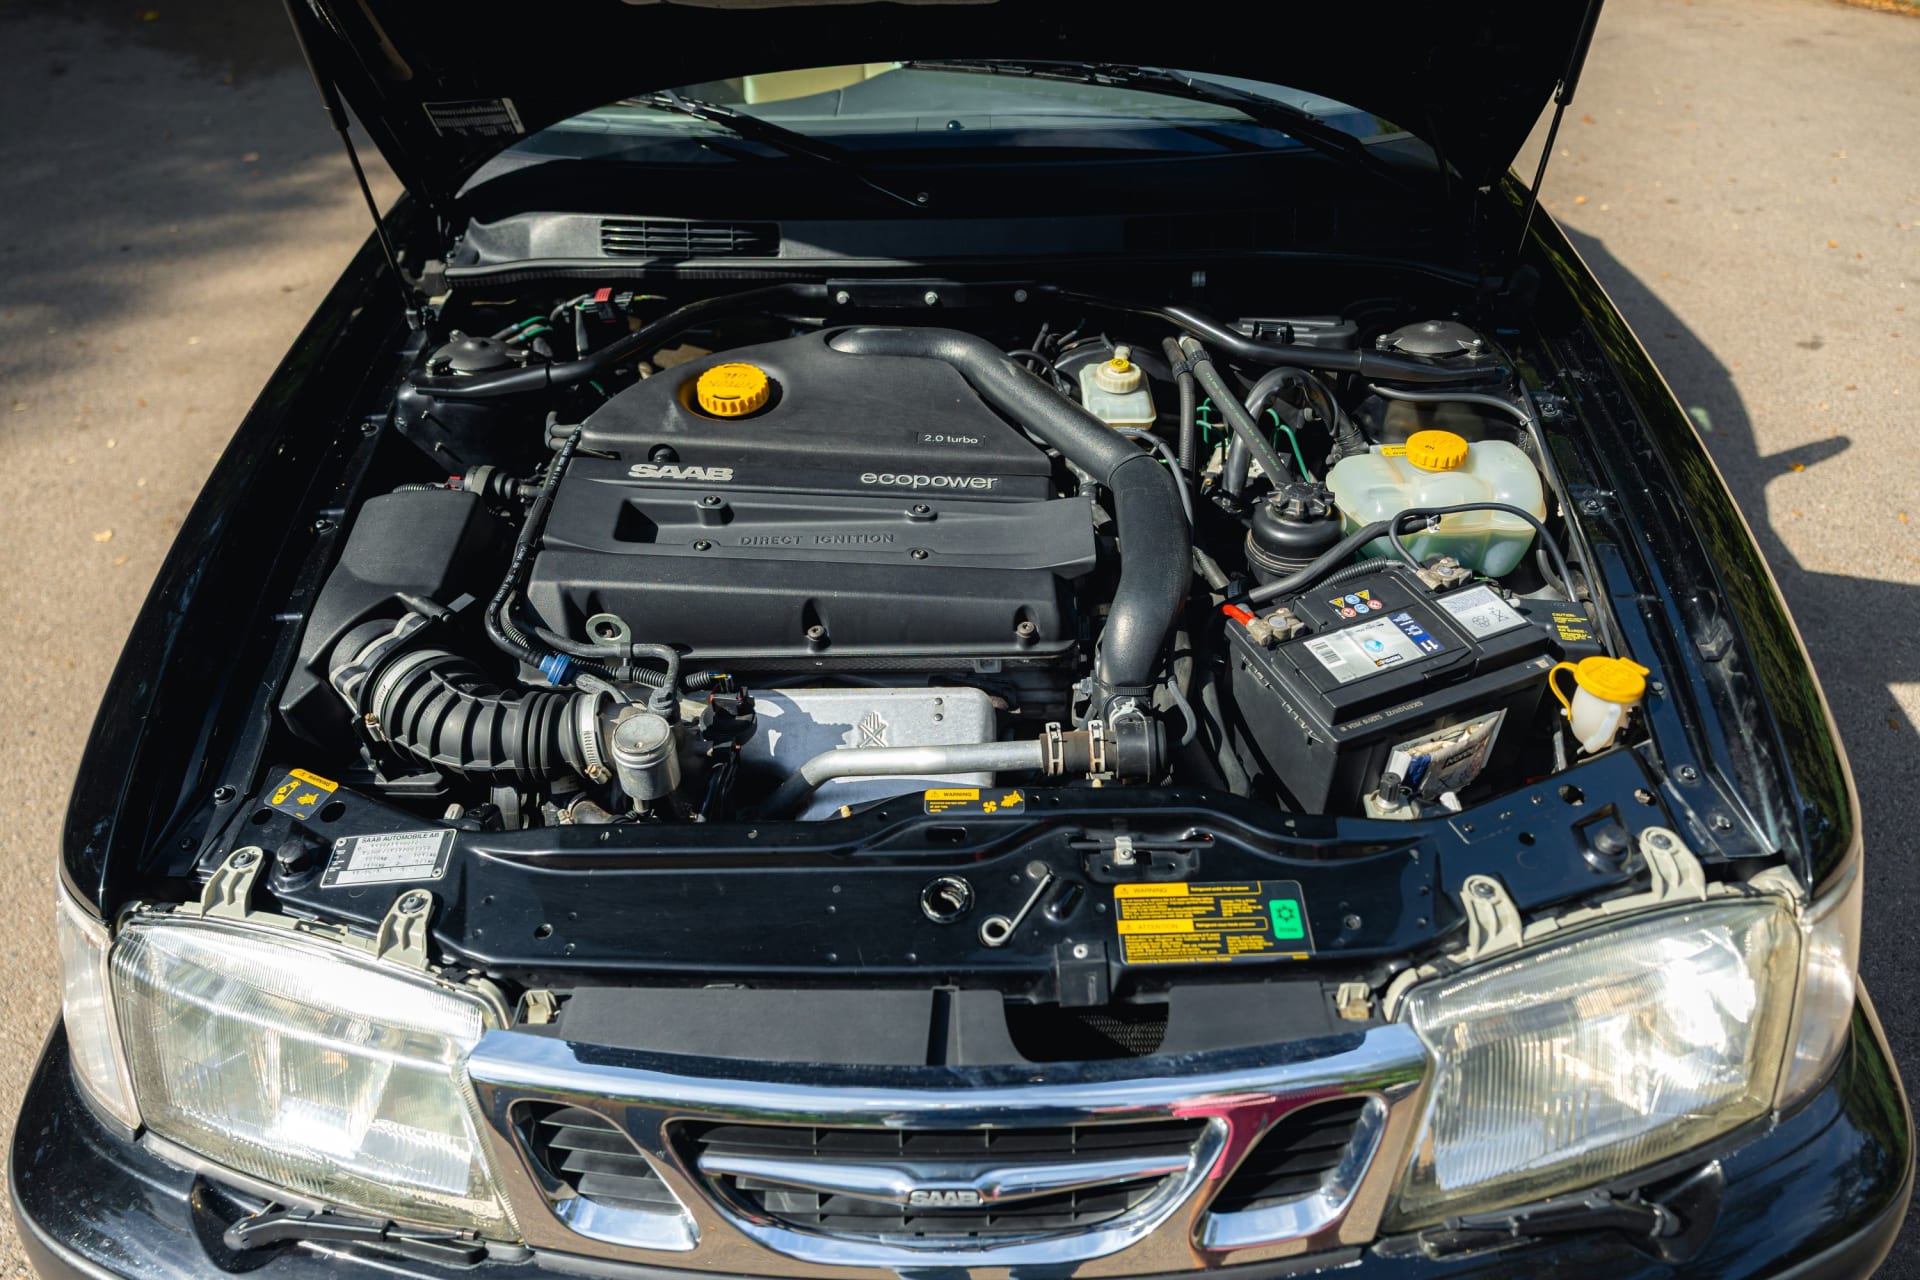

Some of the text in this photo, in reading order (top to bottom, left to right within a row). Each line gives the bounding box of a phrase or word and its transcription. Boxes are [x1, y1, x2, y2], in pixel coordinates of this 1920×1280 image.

[924, 434, 979, 444] 2.0 turbo
[628, 463, 734, 481] SAAB
[860, 472, 998, 489] ecopower
[739, 534, 895, 546] DIRECT IGNITION
[383, 833, 428, 841] AUTOMOBILE
[910, 1190, 979, 1206] SAAB
